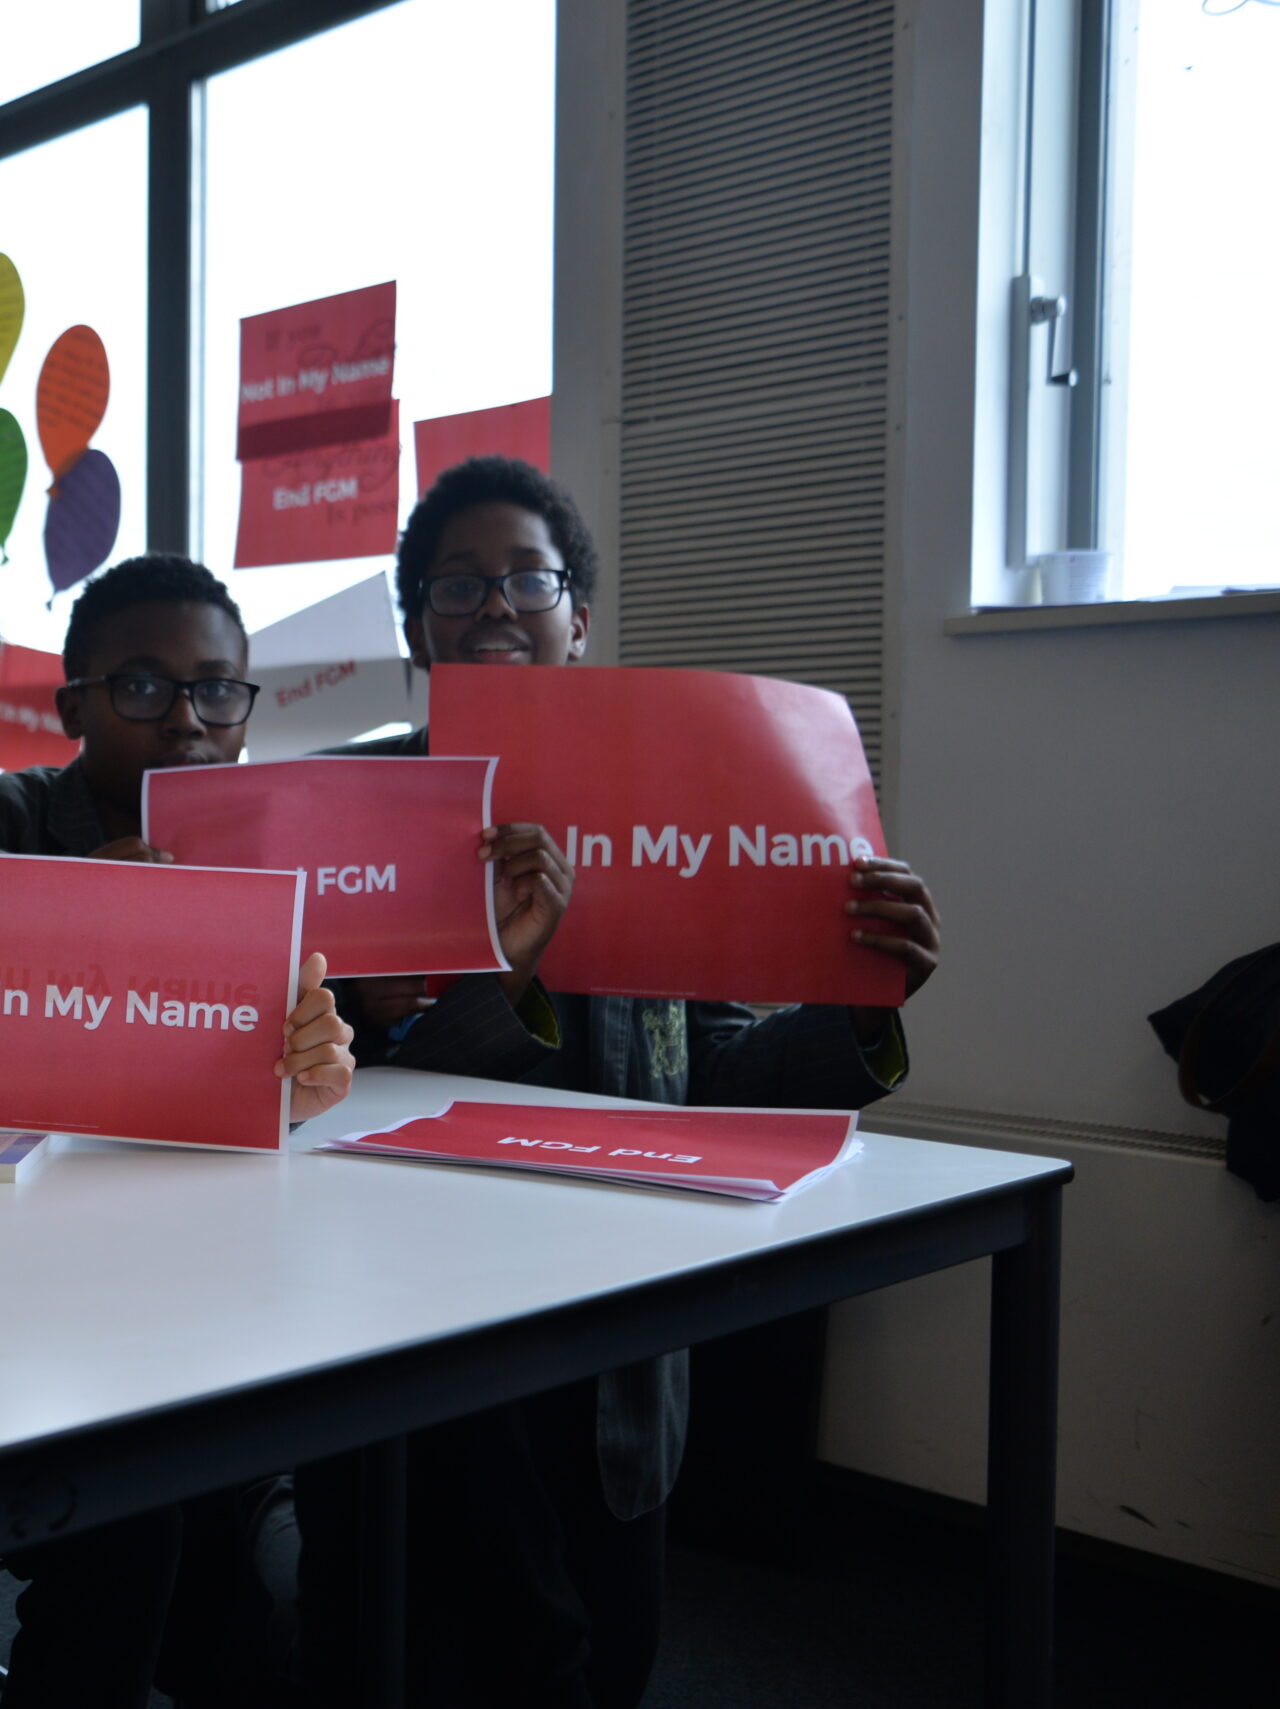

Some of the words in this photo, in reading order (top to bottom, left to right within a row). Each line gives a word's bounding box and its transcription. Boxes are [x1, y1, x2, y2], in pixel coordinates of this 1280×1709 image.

[298, 367, 329, 395] My
[273, 482, 311, 511] End
[313, 474, 359, 504] FGM
[314, 658, 357, 691] FGM
[566, 825, 612, 867] In
[632, 825, 713, 878] My
[728, 824, 874, 867] Name
[317, 863, 396, 895] FGM
[44, 984, 112, 1031] My
[125, 989, 259, 1032] Name
[497, 1136, 602, 1154] FGM
[608, 1148, 703, 1164] End
